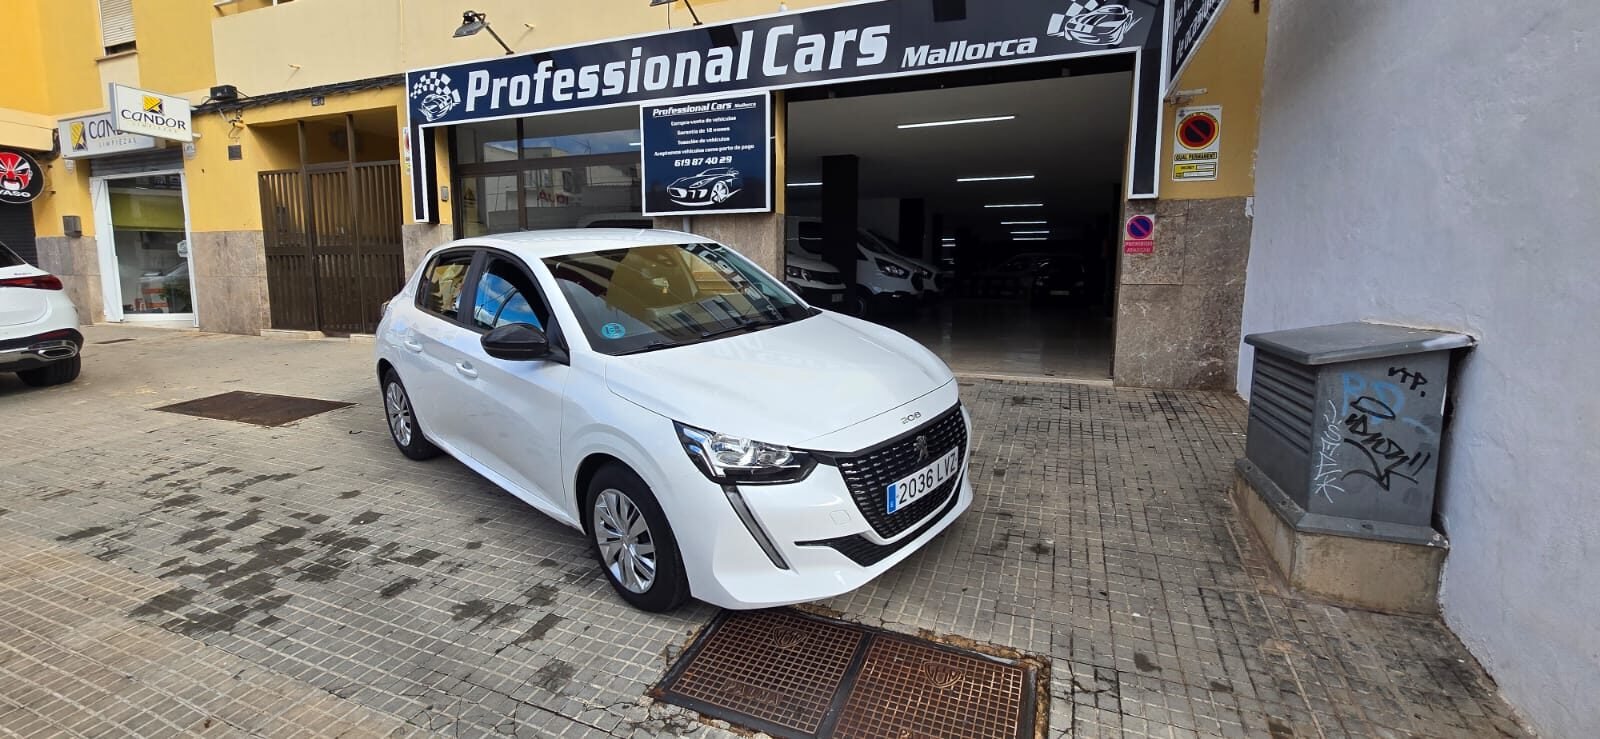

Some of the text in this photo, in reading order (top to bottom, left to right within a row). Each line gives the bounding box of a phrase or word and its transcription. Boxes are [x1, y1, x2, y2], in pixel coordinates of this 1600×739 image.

[464, 24, 1038, 112] Professional Cars Mallorca
[653, 103, 710, 117] Professional
[711, 102, 732, 111] Cars
[88, 119, 125, 140] CAN
[674, 156, 732, 167] 619 87 40 29
[900, 411, 922, 425] 208
[898, 452, 956, 504] 2036 LVZ
